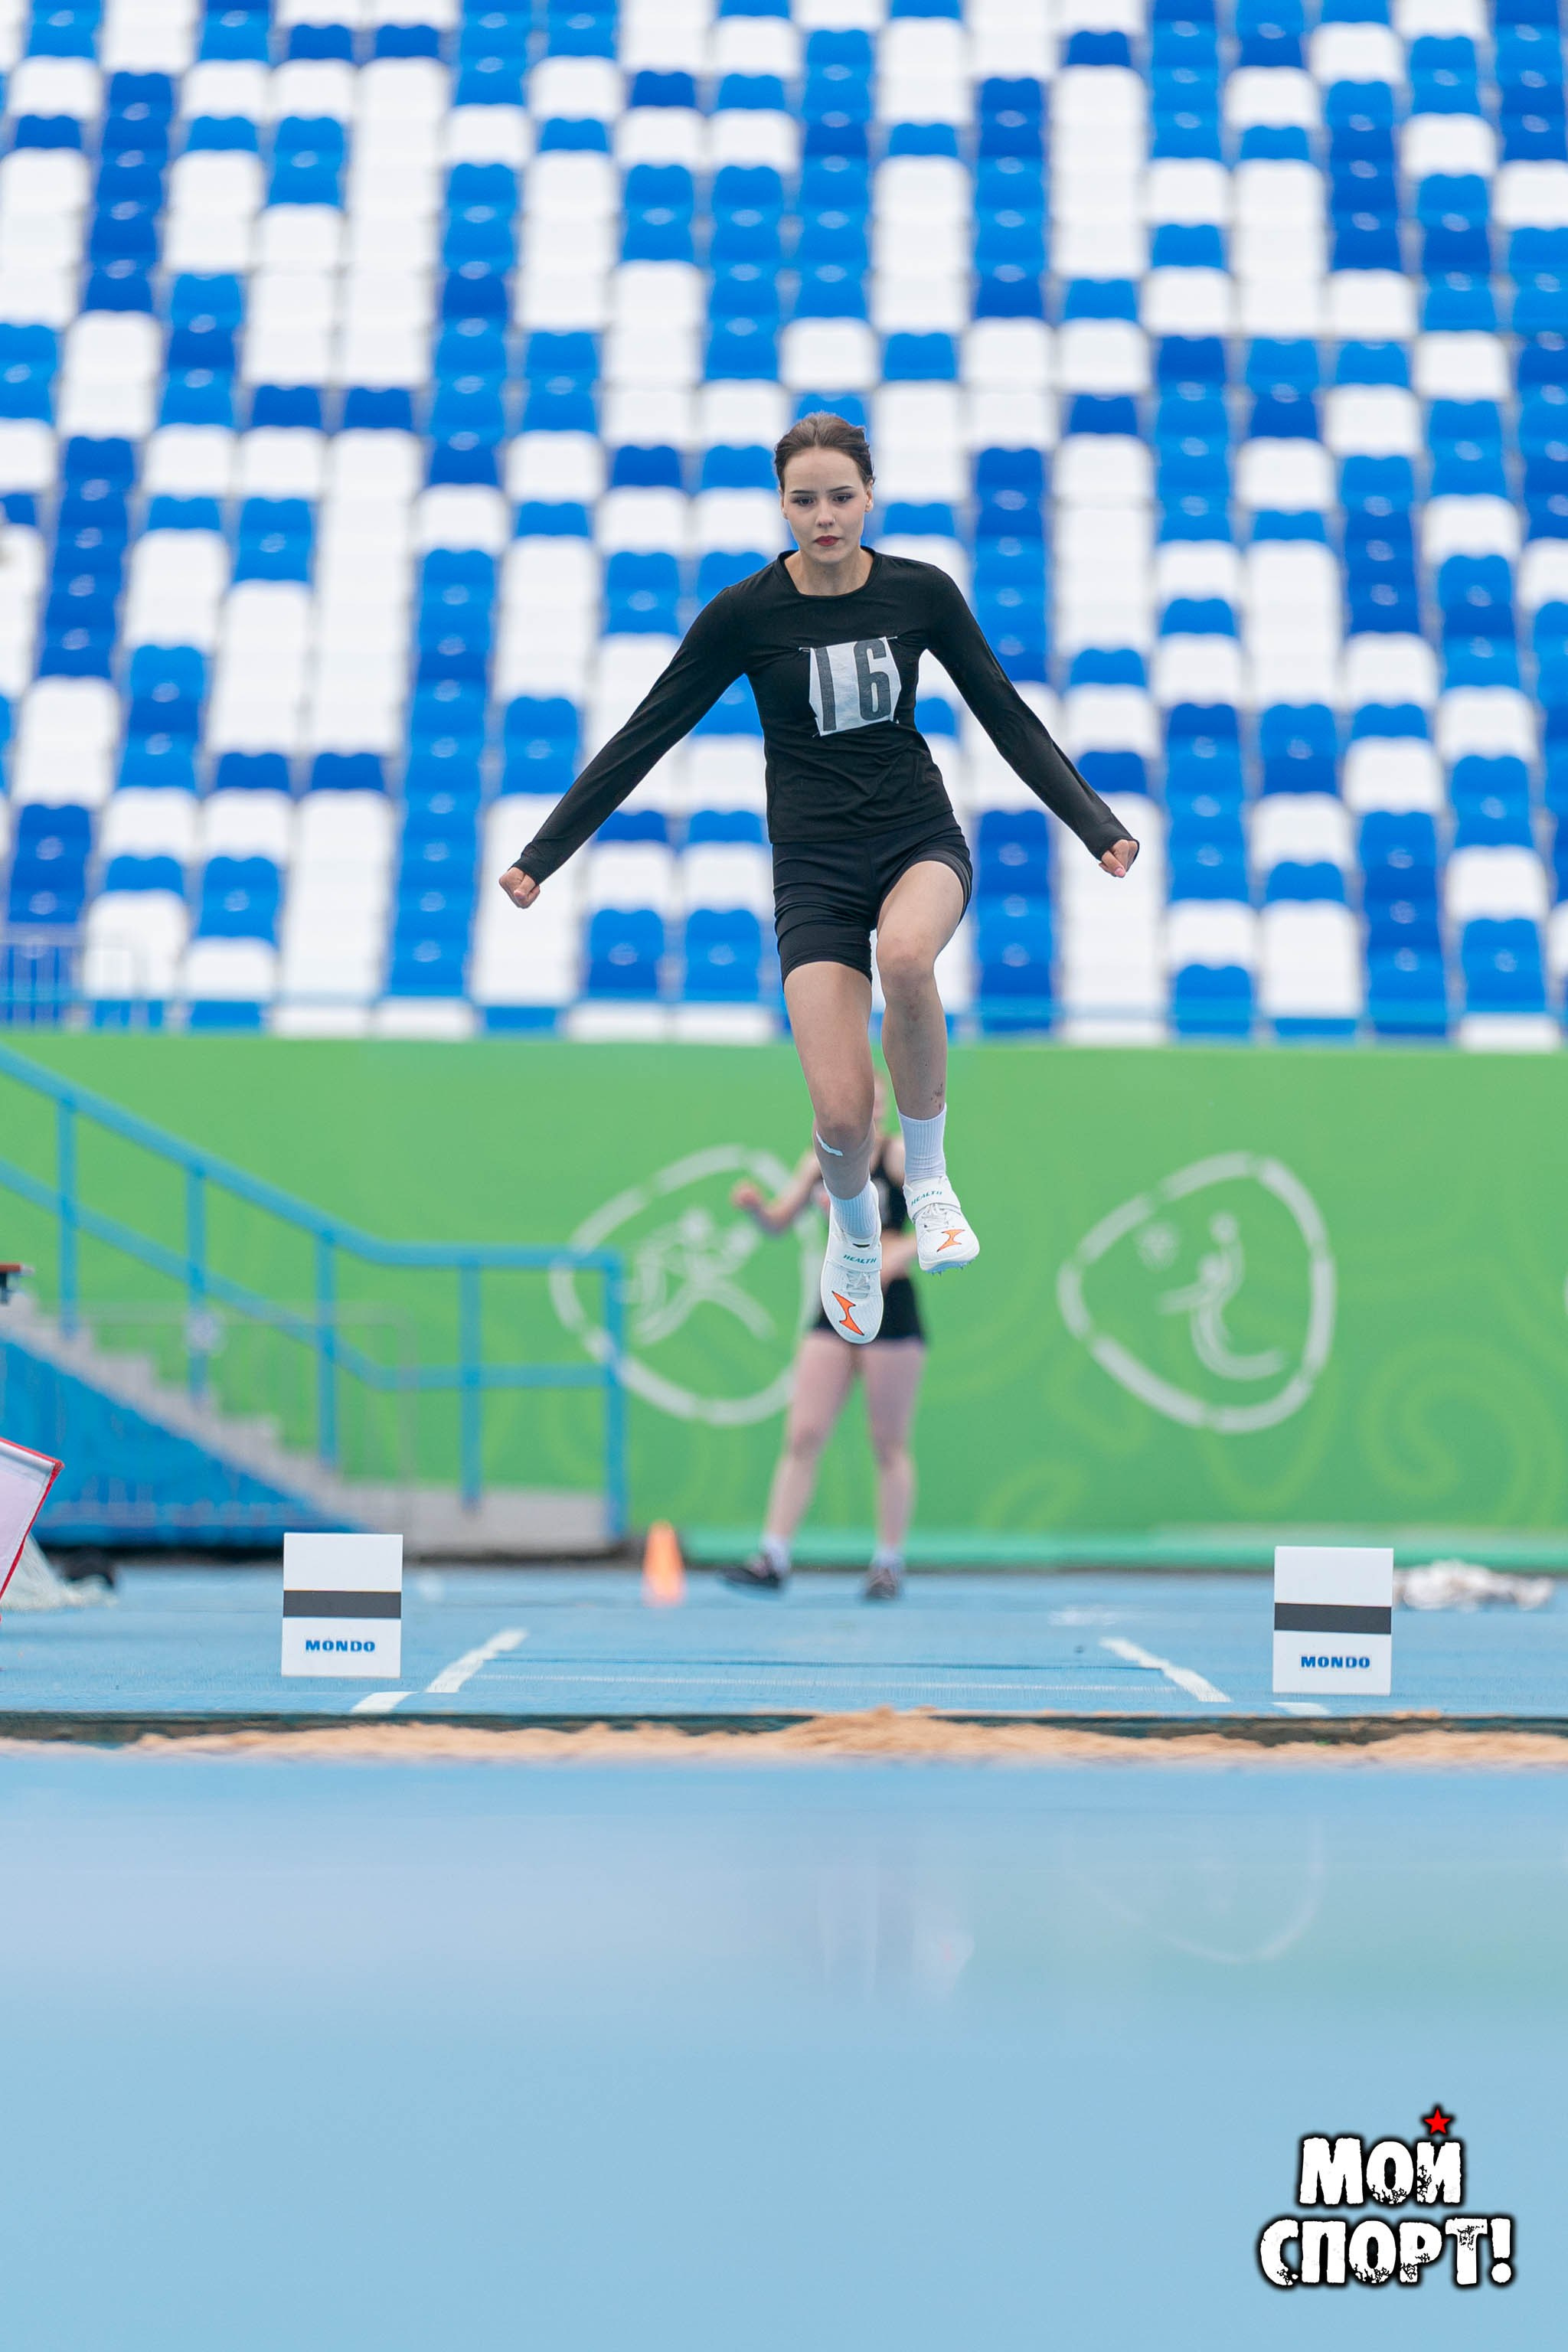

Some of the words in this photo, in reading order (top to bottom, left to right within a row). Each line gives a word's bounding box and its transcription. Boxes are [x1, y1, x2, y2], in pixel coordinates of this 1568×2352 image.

[815, 639, 891, 731] 16
[843, 1254, 877, 1264] HEALTH
[305, 1640, 375, 1652] MONDO
[1301, 1656, 1370, 1668] MONDO
